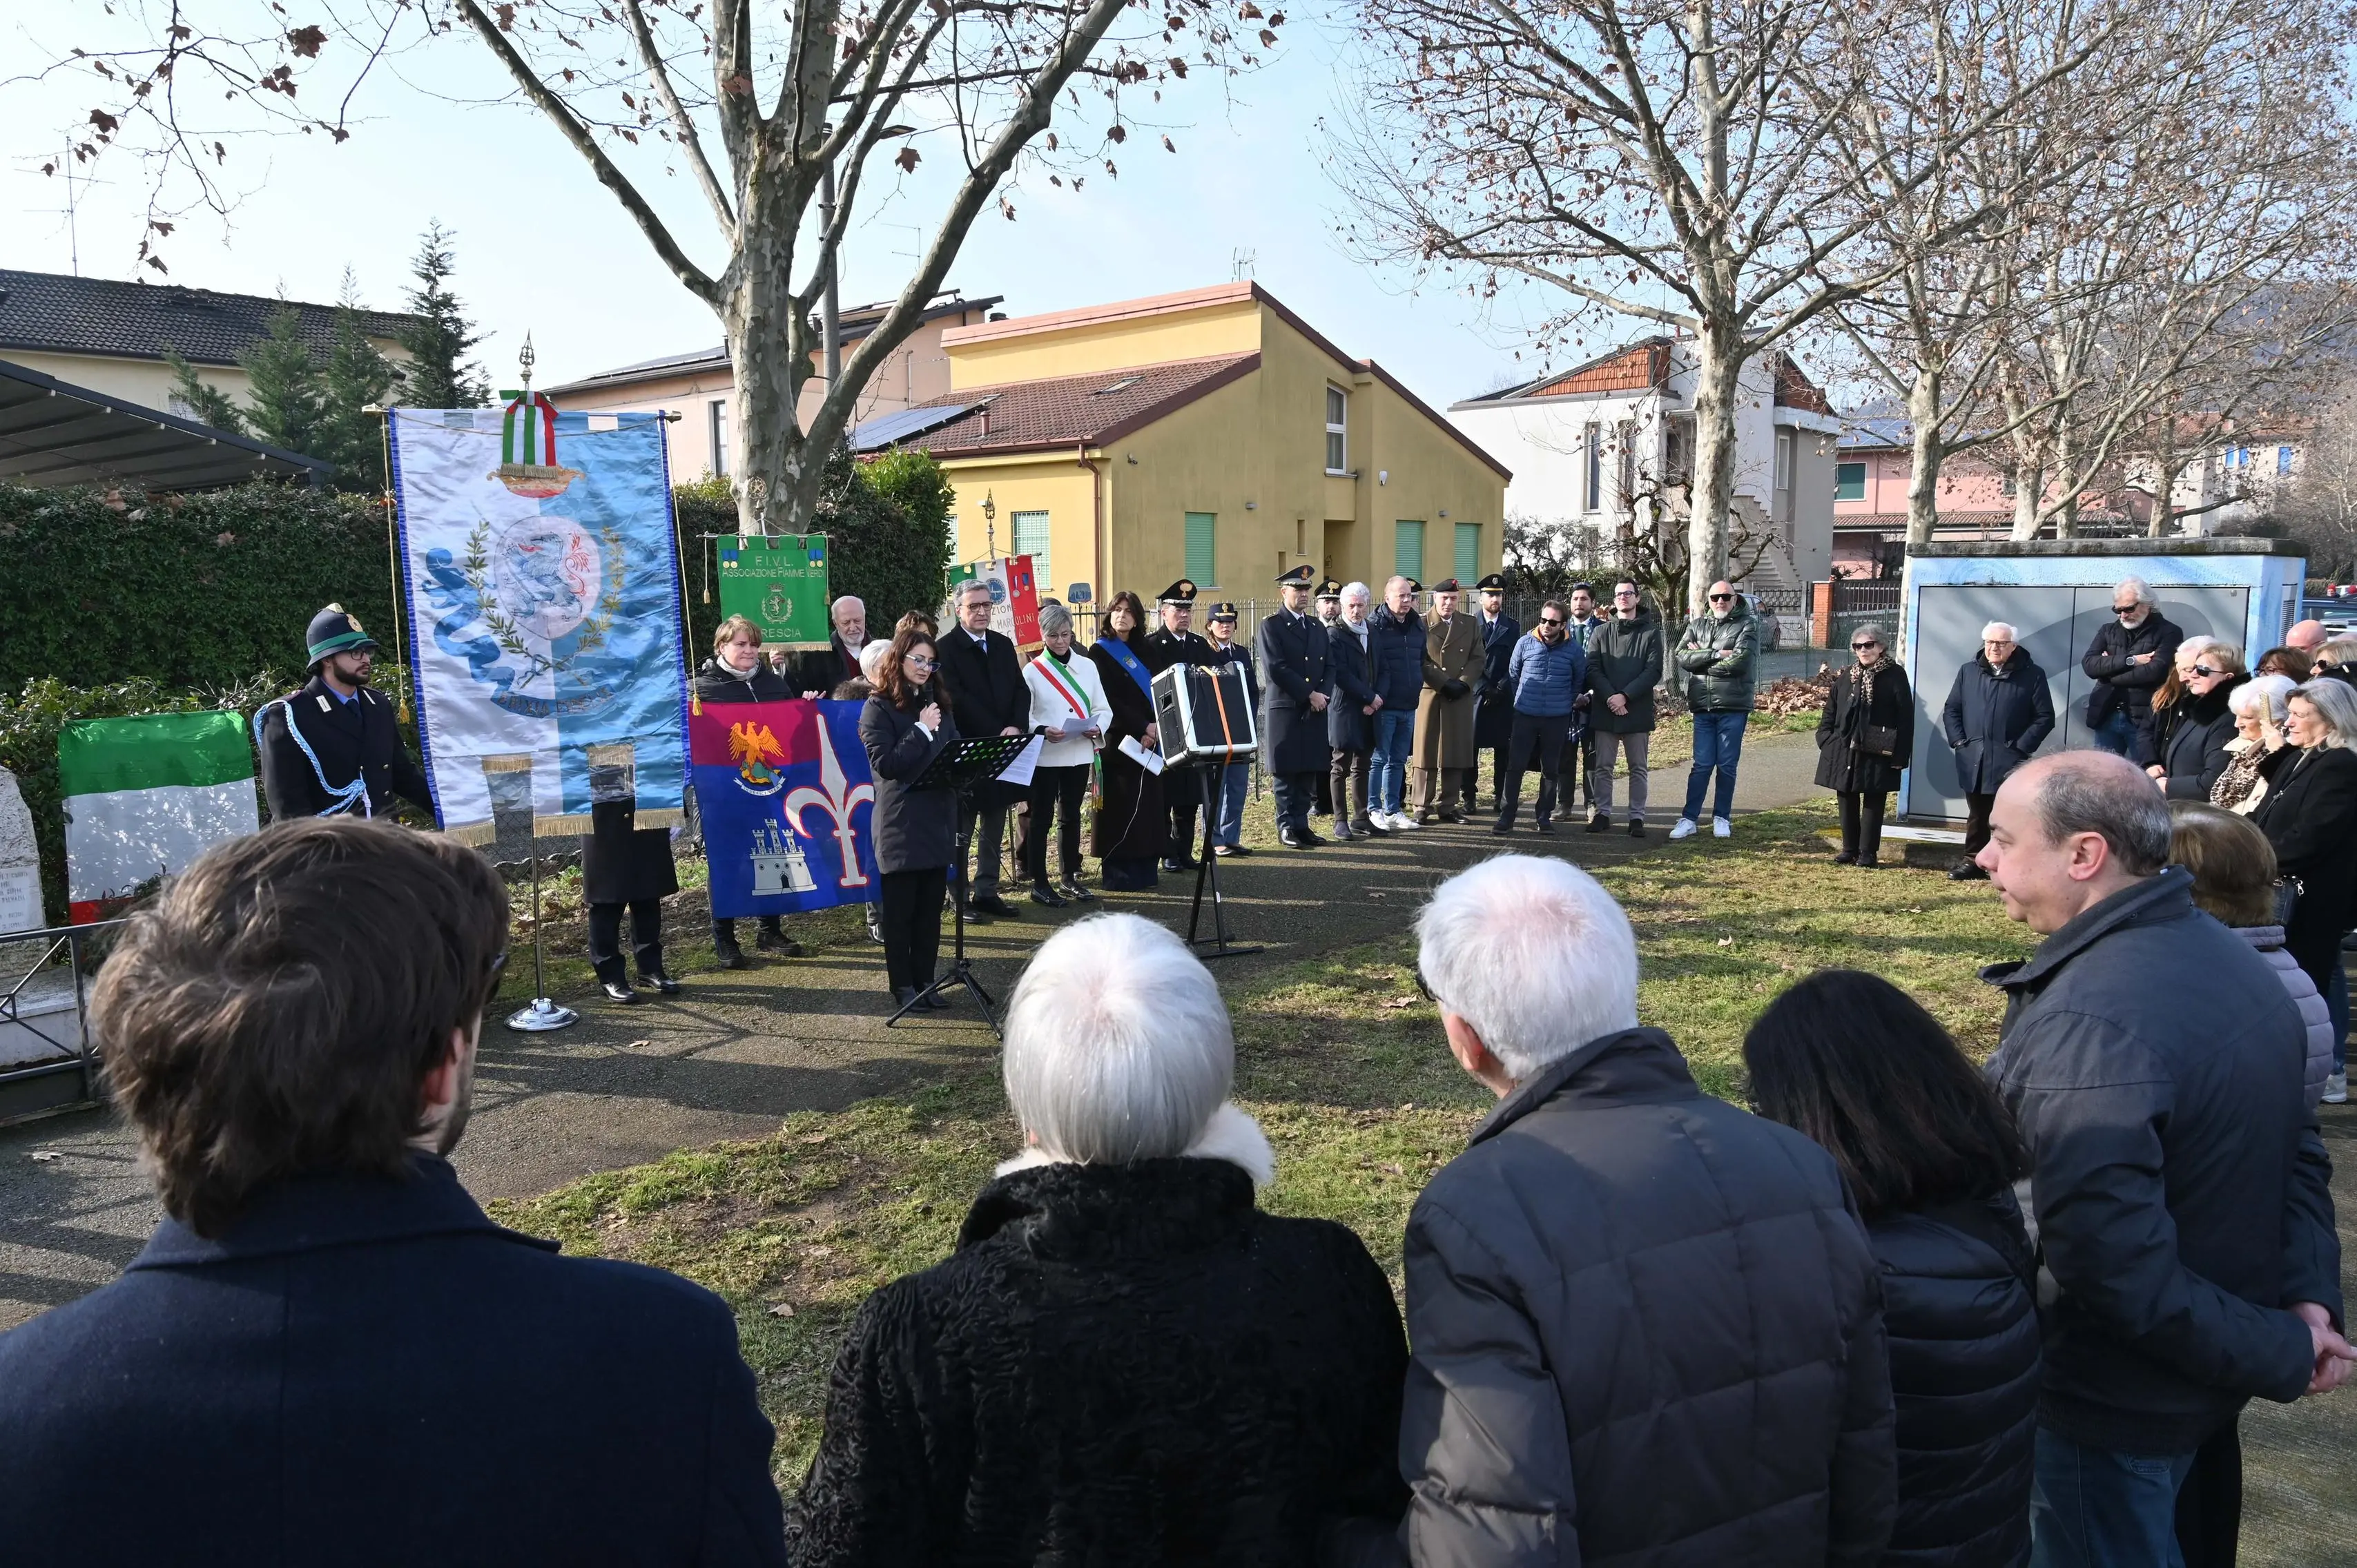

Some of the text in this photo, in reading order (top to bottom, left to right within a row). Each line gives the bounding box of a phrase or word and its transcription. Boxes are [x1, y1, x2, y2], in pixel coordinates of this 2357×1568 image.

[722, 568, 777, 578] ASSOCIAZIONE
[777, 567, 805, 577] FIAMME
[996, 612, 1035, 630] MARCOLINI
[761, 628, 801, 638] RESCIA
